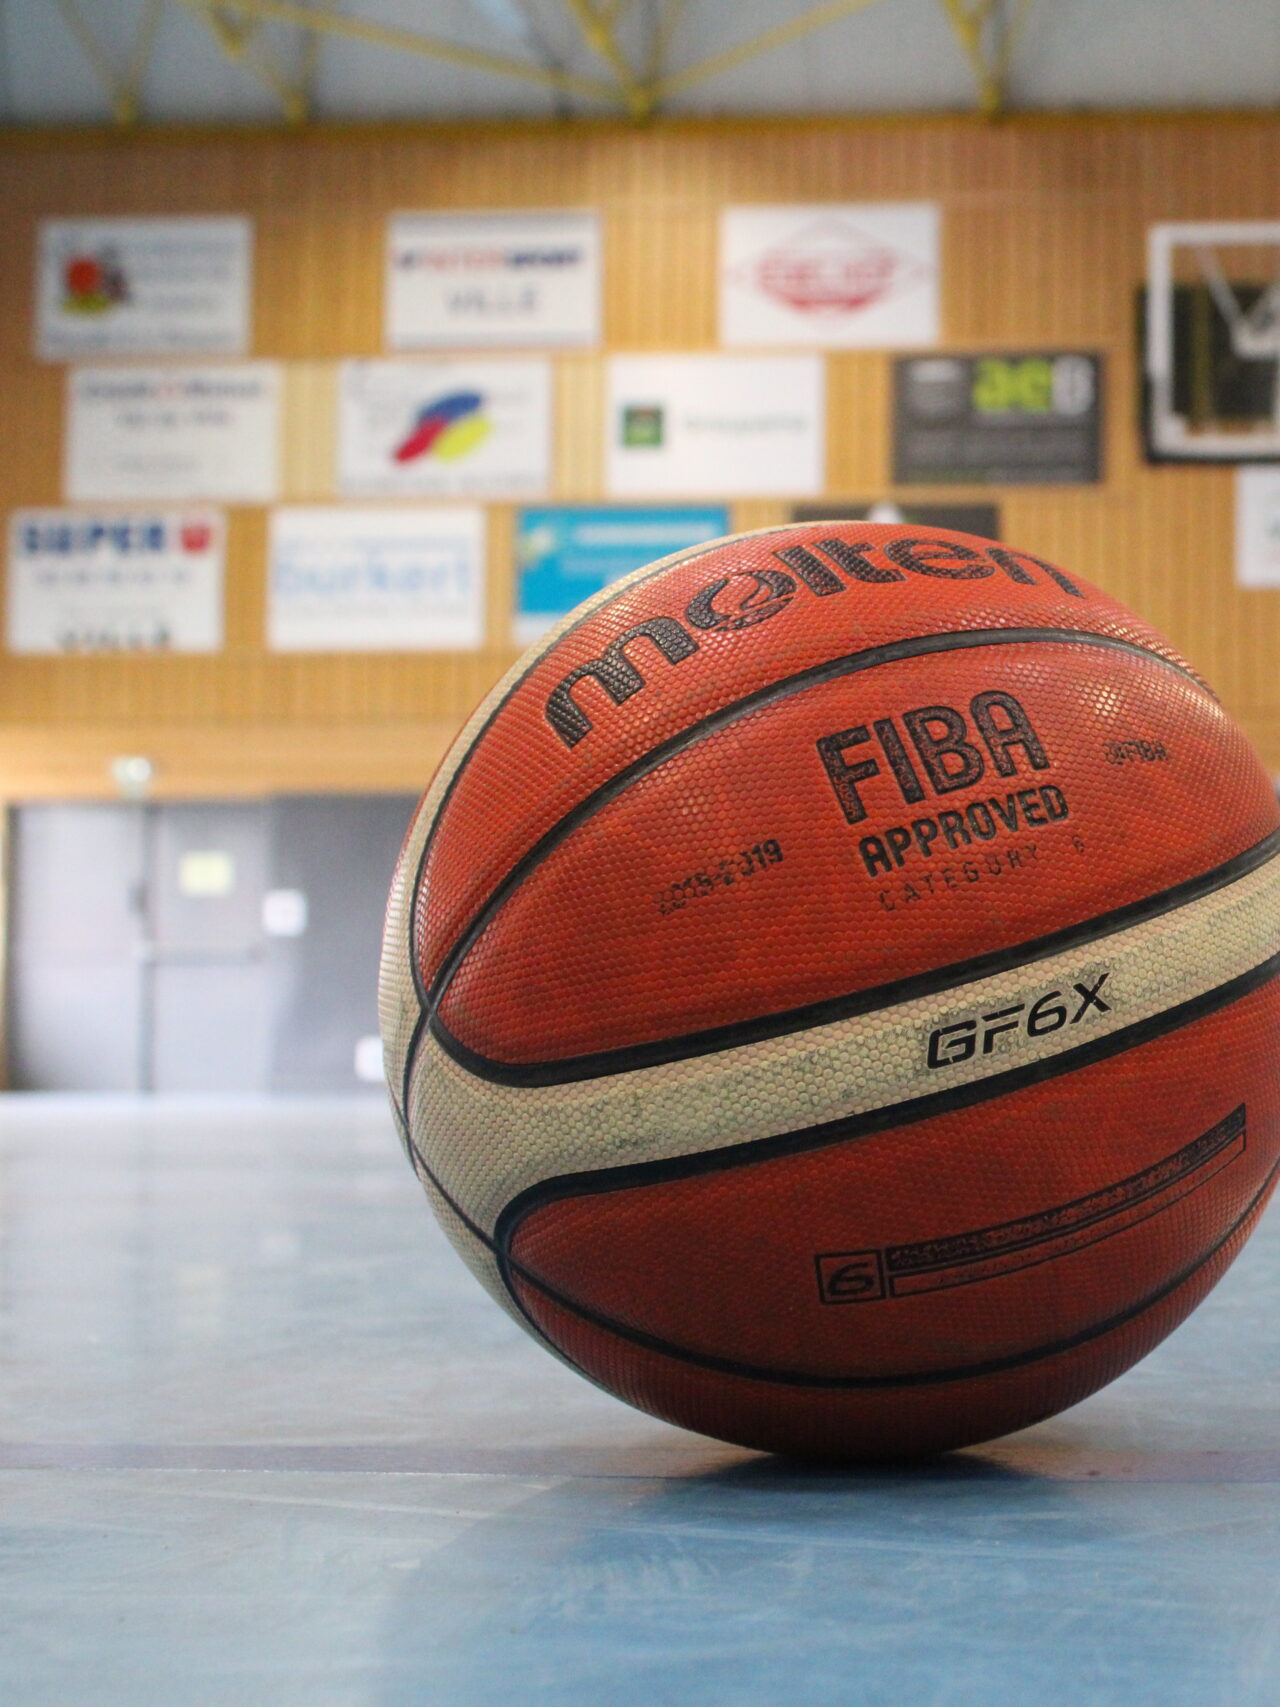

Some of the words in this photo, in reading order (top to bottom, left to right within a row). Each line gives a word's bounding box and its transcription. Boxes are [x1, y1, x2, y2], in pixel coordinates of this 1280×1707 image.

[545, 536, 1085, 749] molten
[815, 689, 1050, 826] FIBA
[858, 784, 1069, 878] APPROVED
[879, 844, 1038, 911] CATEGORY
[926, 972, 1112, 1069] GF6X
[827, 1261, 874, 1297] 6
